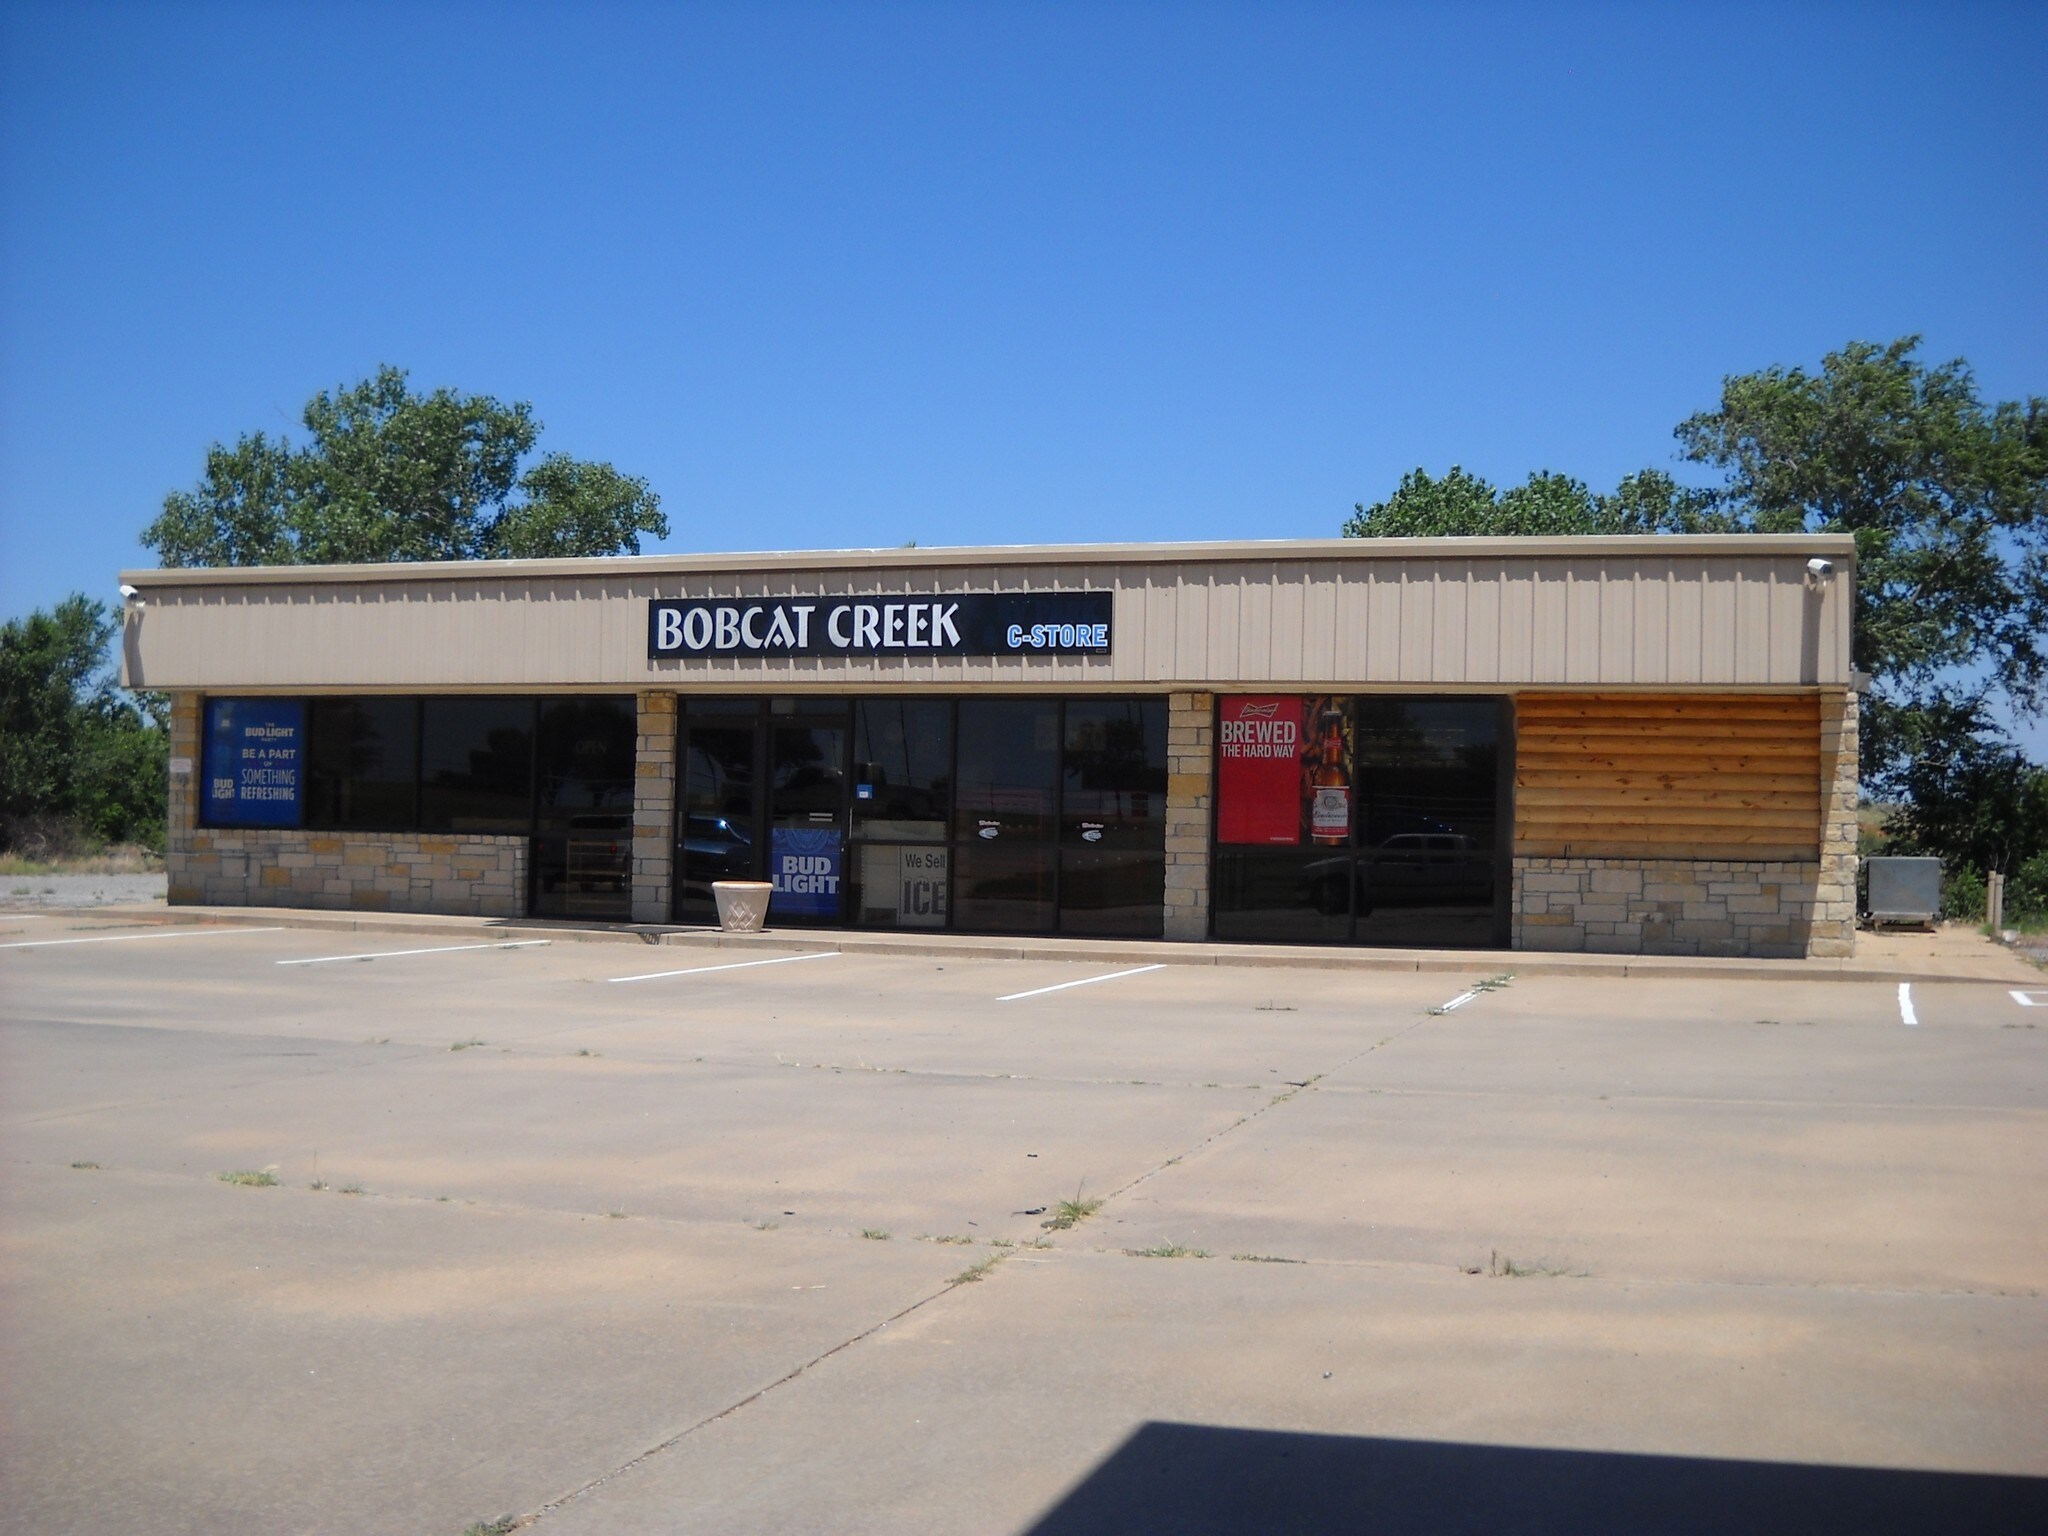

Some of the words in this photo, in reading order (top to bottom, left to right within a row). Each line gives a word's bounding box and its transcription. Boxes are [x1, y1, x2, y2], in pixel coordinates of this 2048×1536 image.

[657, 605, 815, 651] BOBCAT
[828, 602, 961, 649] CREEK
[1007, 623, 1108, 648] C-STORE
[245, 728, 265, 736] BUD
[266, 728, 294, 737] LIGHT
[1221, 721, 1296, 744] BREWED
[242, 749, 255, 759] BE
[258, 749, 266, 759] A
[268, 749, 296, 759] PART
[1221, 744, 1241, 757] THE
[1243, 745, 1271, 757] HARD
[1273, 745, 1295, 758] WAY
[213, 779, 234, 788] BUD
[241, 769, 295, 785] SOMETHING
[241, 787, 295, 801] REFRESHING
[782, 856, 832, 875] BUD
[905, 854, 922, 868] We
[925, 853, 946, 868] Sell
[772, 875, 839, 894] LIGHT
[903, 877, 947, 916] ICE
